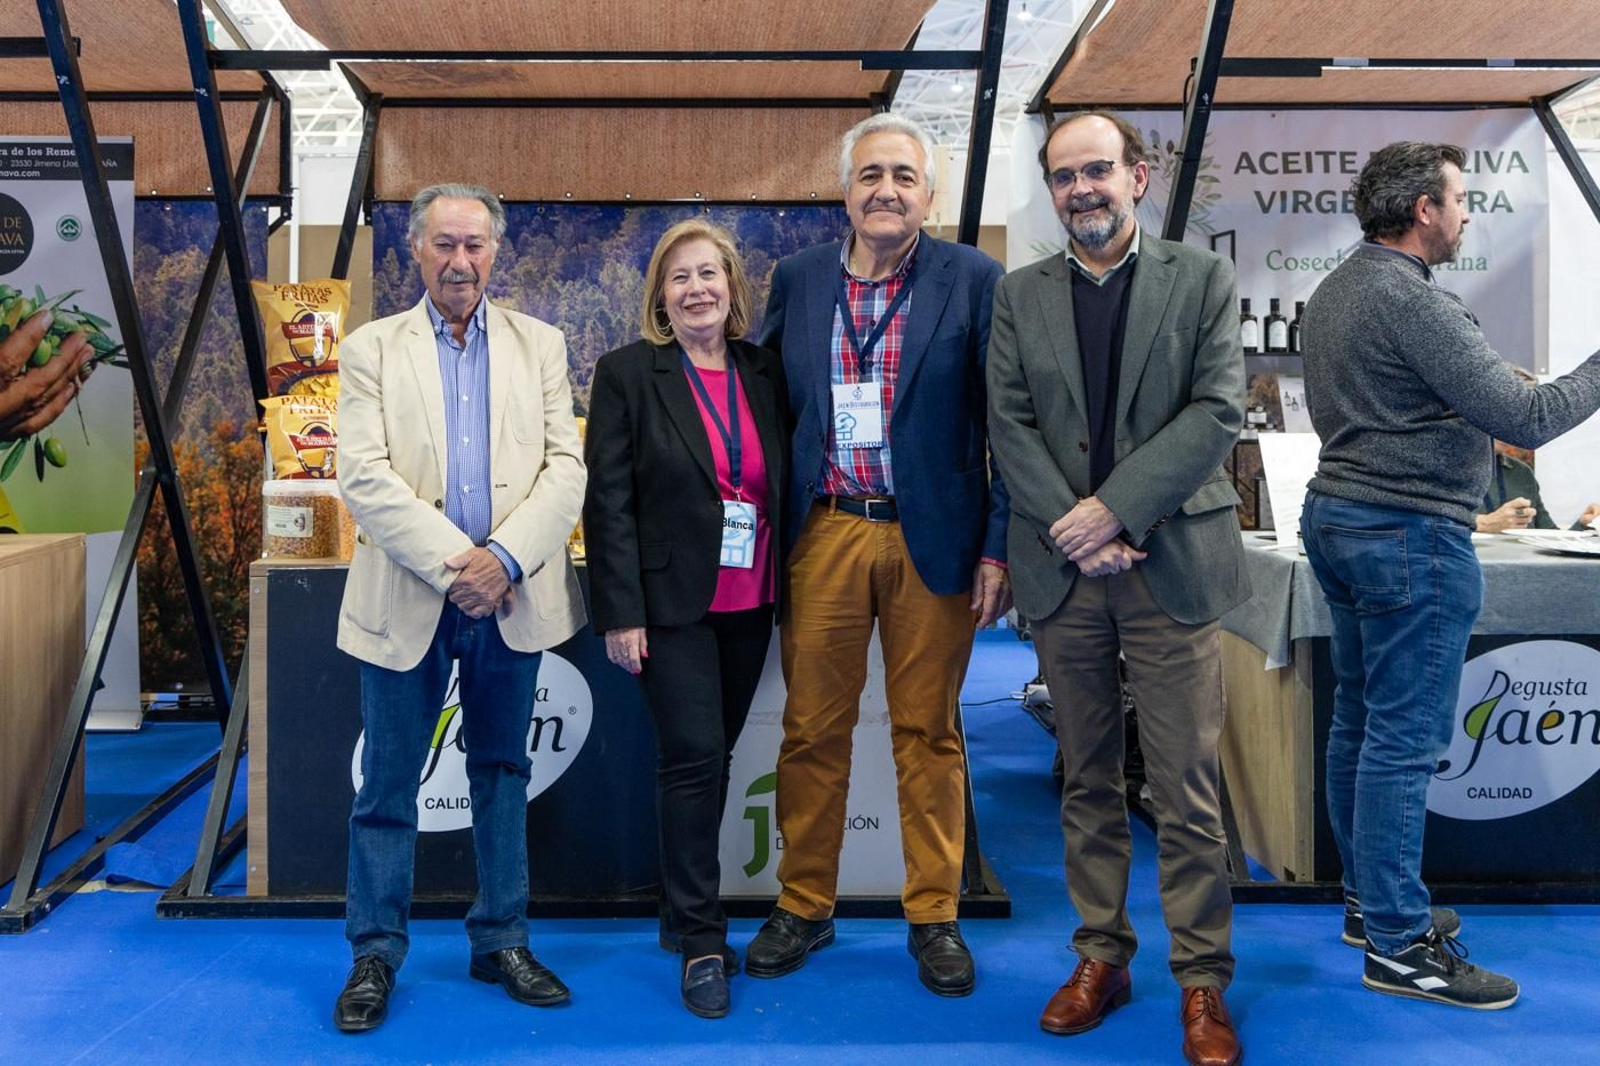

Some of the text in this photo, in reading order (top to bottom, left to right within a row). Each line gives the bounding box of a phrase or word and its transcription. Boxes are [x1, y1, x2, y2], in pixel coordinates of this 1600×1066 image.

[11, 147, 24, 156] de
[27, 147, 42, 156] los
[1234, 150, 1356, 174] ACEITE
[4, 217, 22, 228] DE
[281, 291, 329, 304] FRITAS
[722, 517, 754, 531] Blanca
[1467, 787, 1533, 799] CALIDAD
